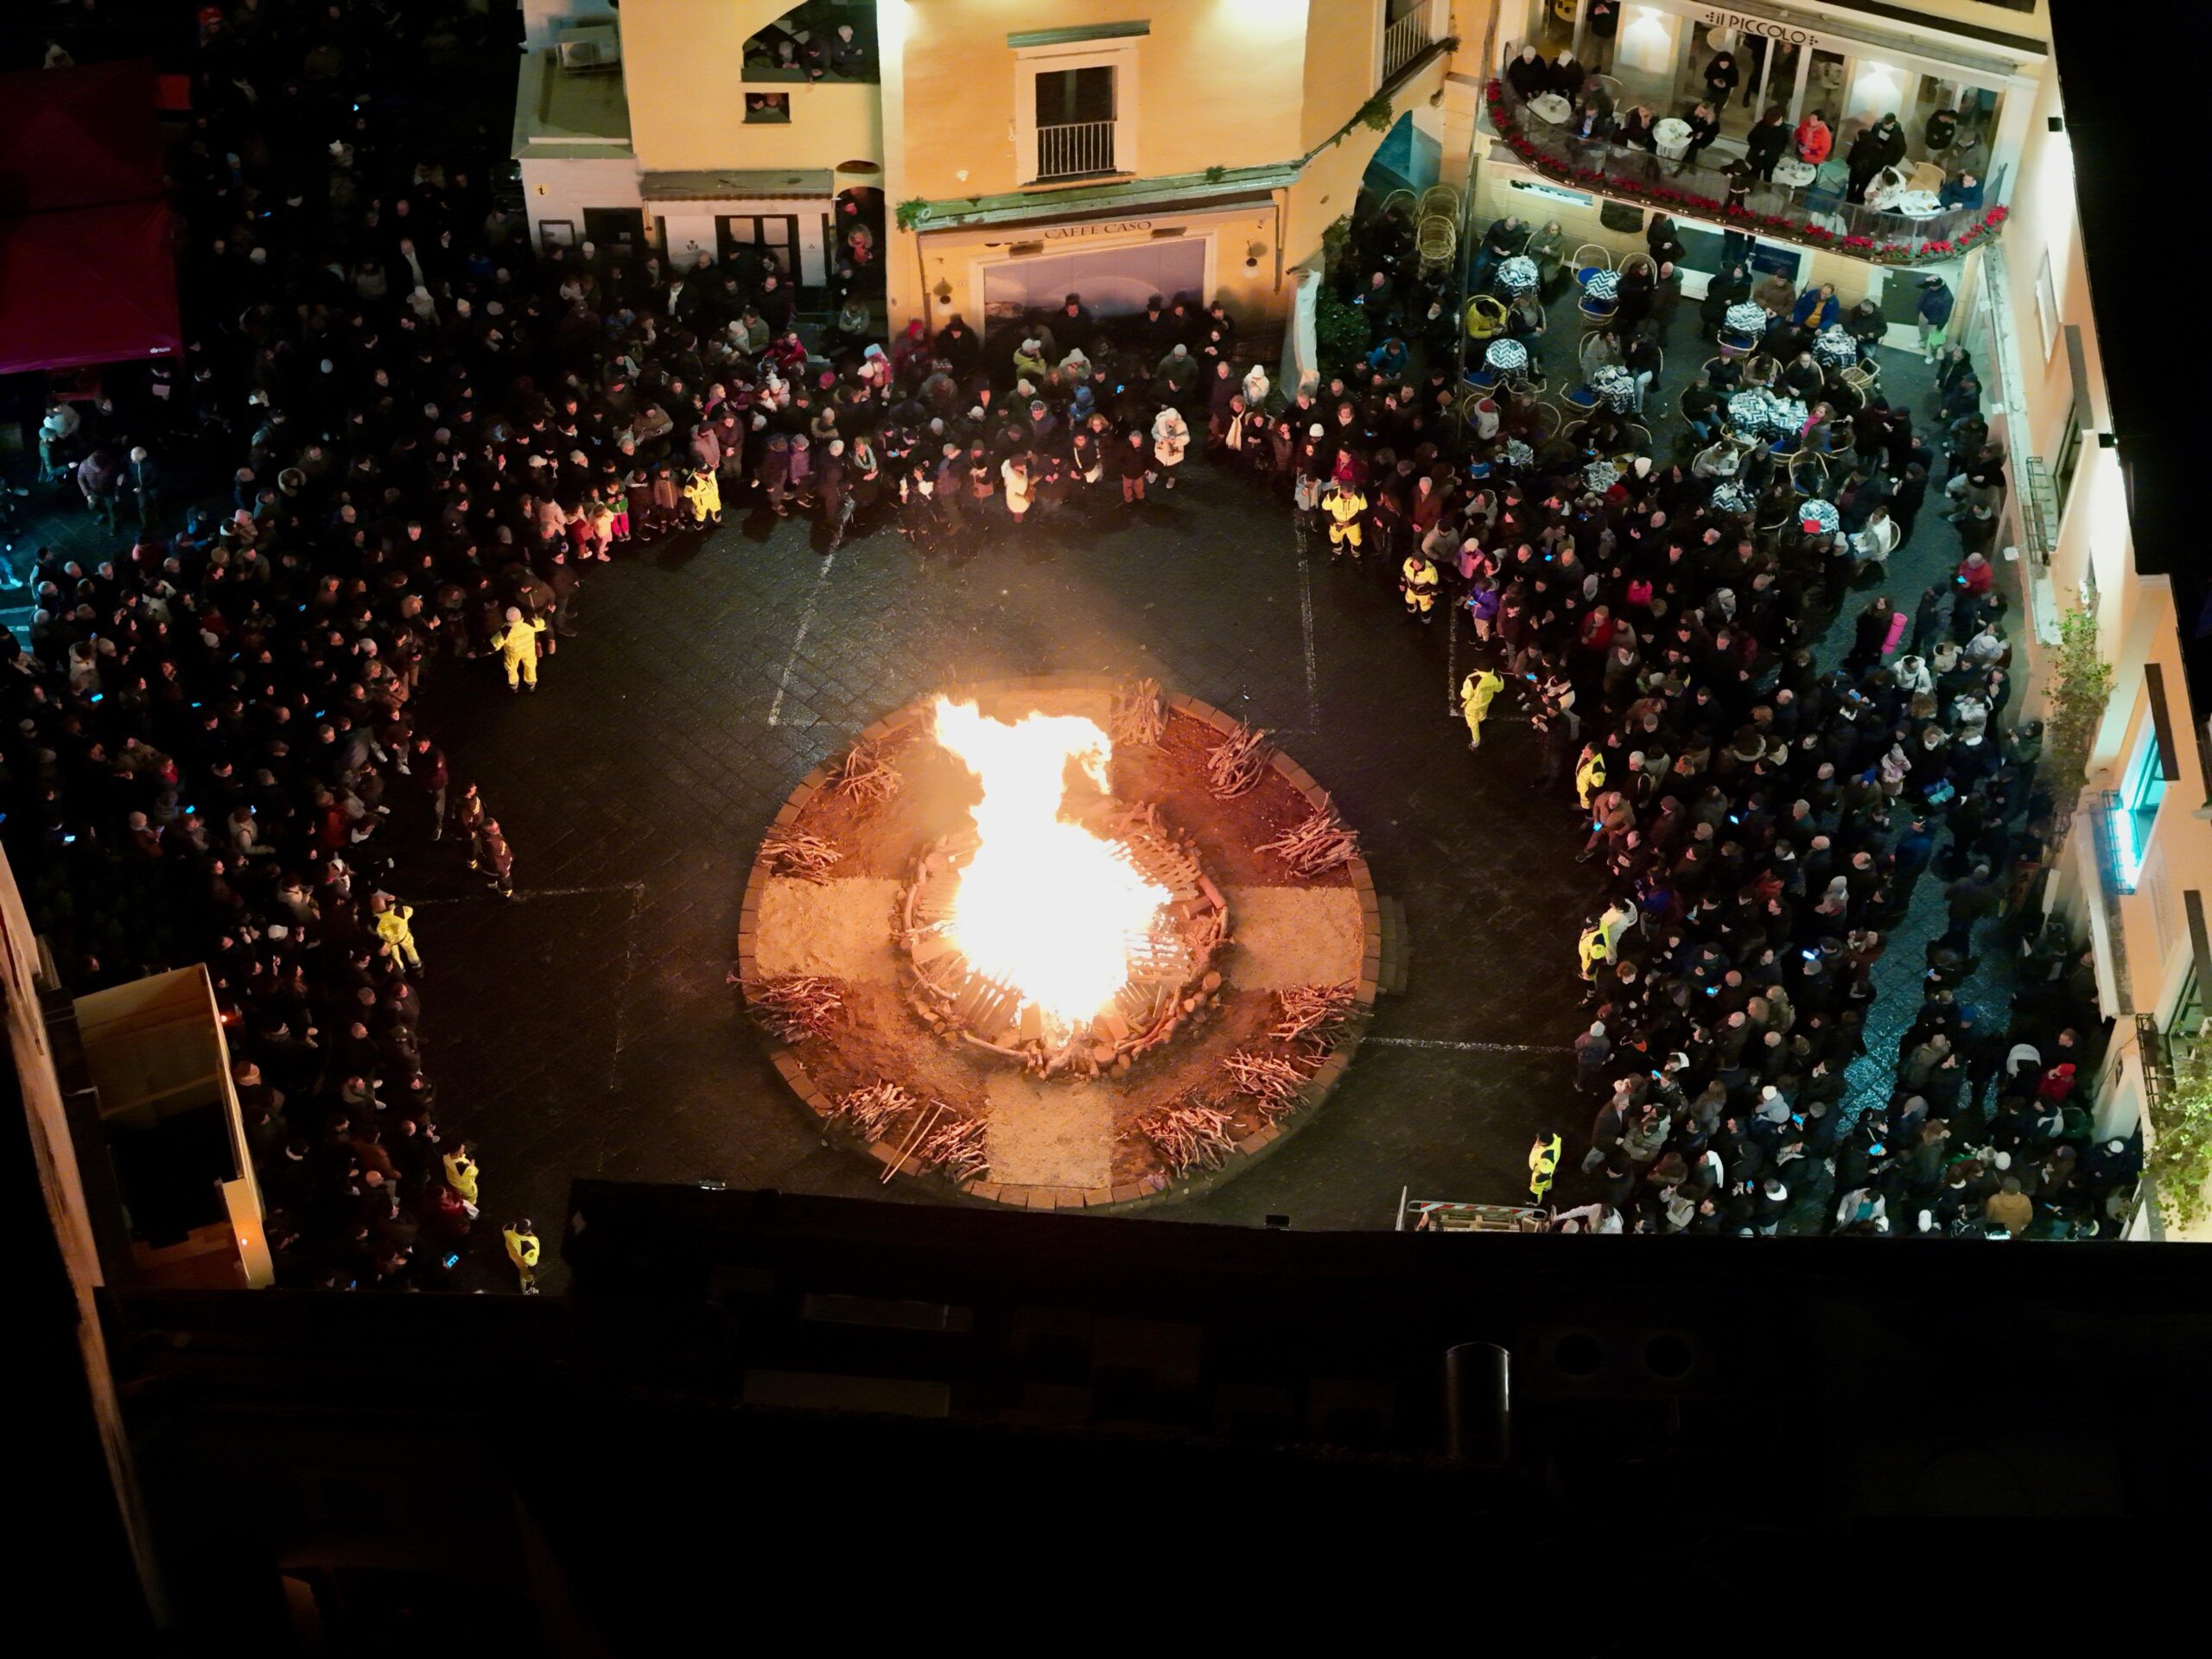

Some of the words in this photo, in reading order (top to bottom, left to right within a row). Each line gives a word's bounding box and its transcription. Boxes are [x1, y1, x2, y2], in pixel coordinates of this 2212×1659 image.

[1716, 13, 1726, 26] il
[1729, 15, 1807, 43] PICCOLO
[1103, 219, 1152, 234] CASO
